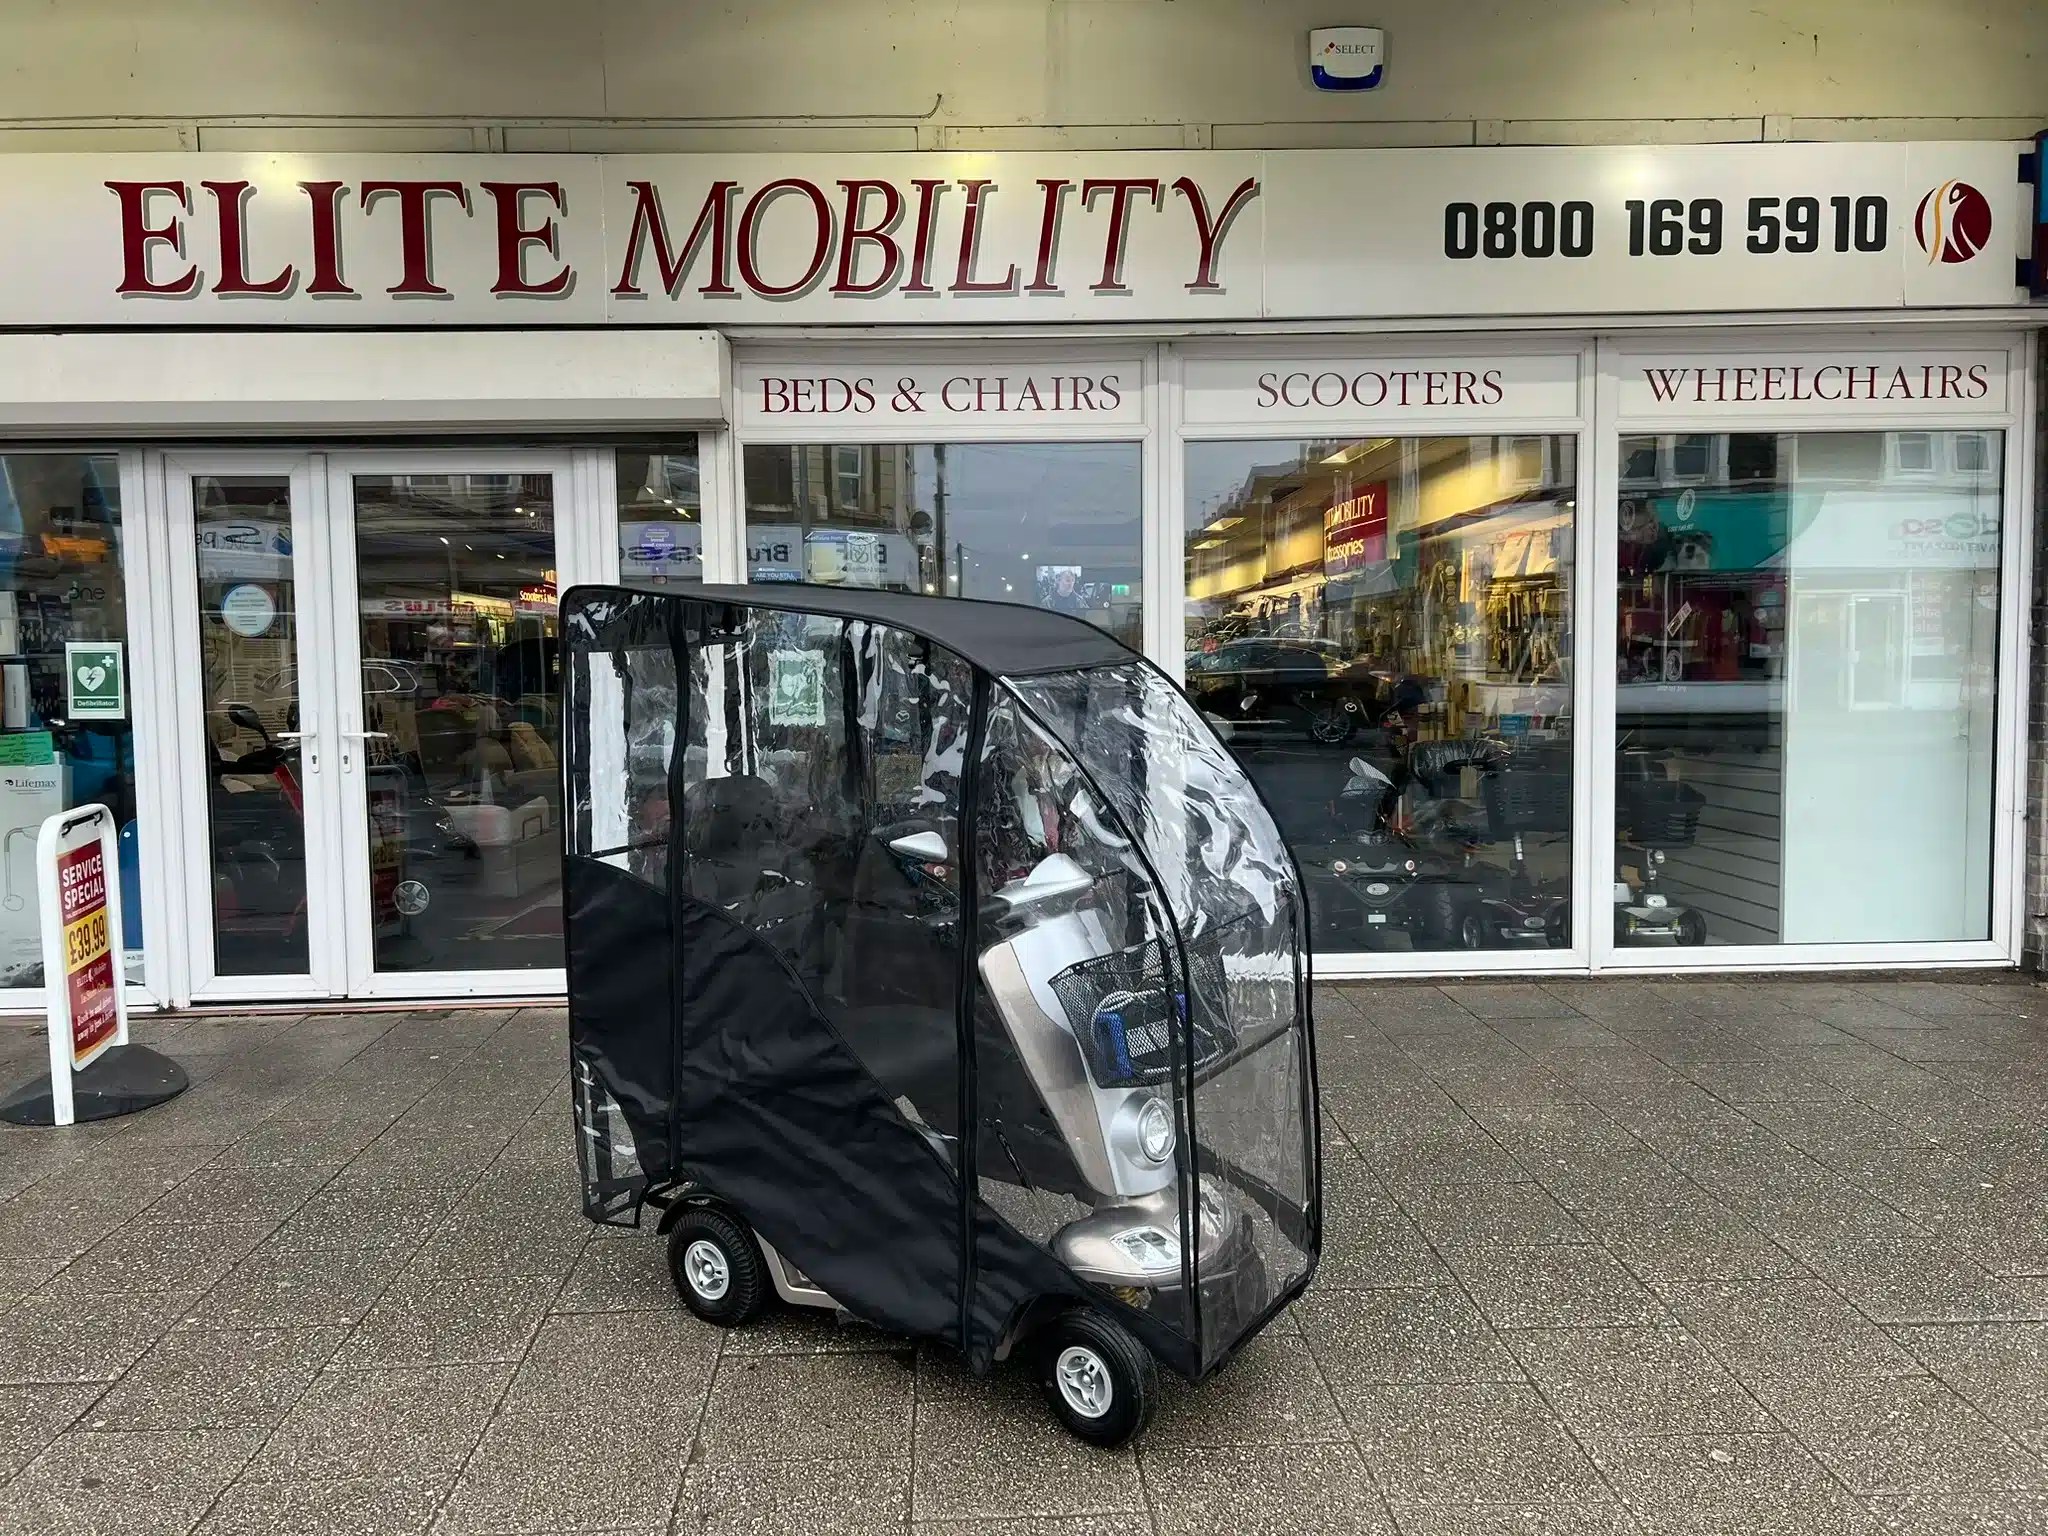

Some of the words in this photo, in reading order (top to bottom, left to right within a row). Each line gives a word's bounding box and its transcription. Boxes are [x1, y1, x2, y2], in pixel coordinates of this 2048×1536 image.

[1335, 44, 1376, 54] SELECT
[104, 180, 577, 300] ELITE
[610, 175, 1261, 300] MOBILITY
[1444, 200, 1595, 260] 0800
[1624, 197, 1724, 258] 169
[1746, 195, 1889, 254] 5910
[759, 377, 876, 414] BEDS
[891, 376, 927, 413] &
[941, 375, 1122, 412] CHAIRS
[1257, 370, 1504, 407] SCOOTERS
[1641, 363, 1990, 404] WHEELCHAIRS
[77, 699, 116, 707] Defibrillator
[15, 778, 57, 788] Lifemax
[62, 854, 103, 888] SERVICE
[64, 876, 104, 910] SPECIAL
[69, 914, 106, 965] £39.99
